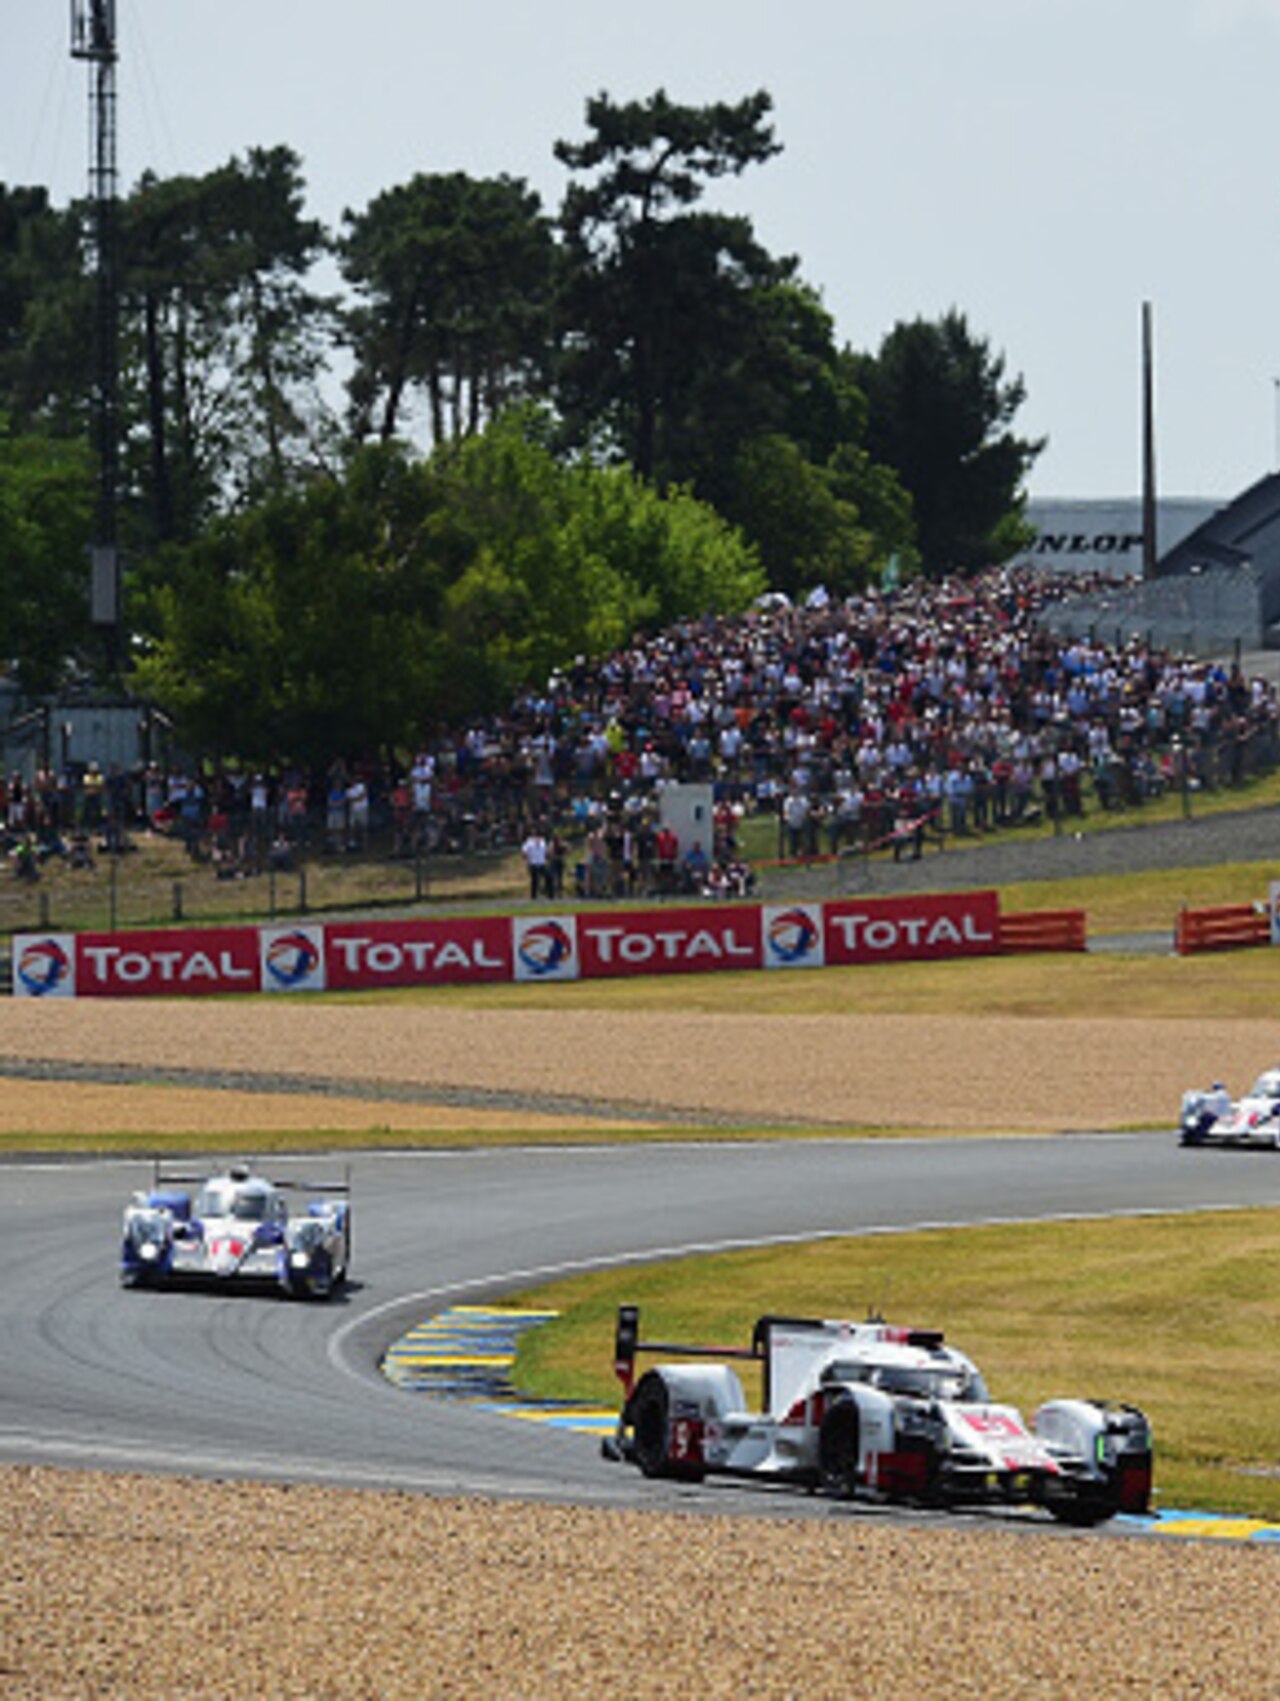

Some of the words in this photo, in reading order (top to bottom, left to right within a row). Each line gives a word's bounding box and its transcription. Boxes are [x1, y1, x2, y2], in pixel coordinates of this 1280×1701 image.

[585, 928, 754, 962] TOTAL
[831, 914, 993, 950] TOTAL
[83, 946, 253, 982] TOTAL
[332, 936, 504, 972] TOTAL
